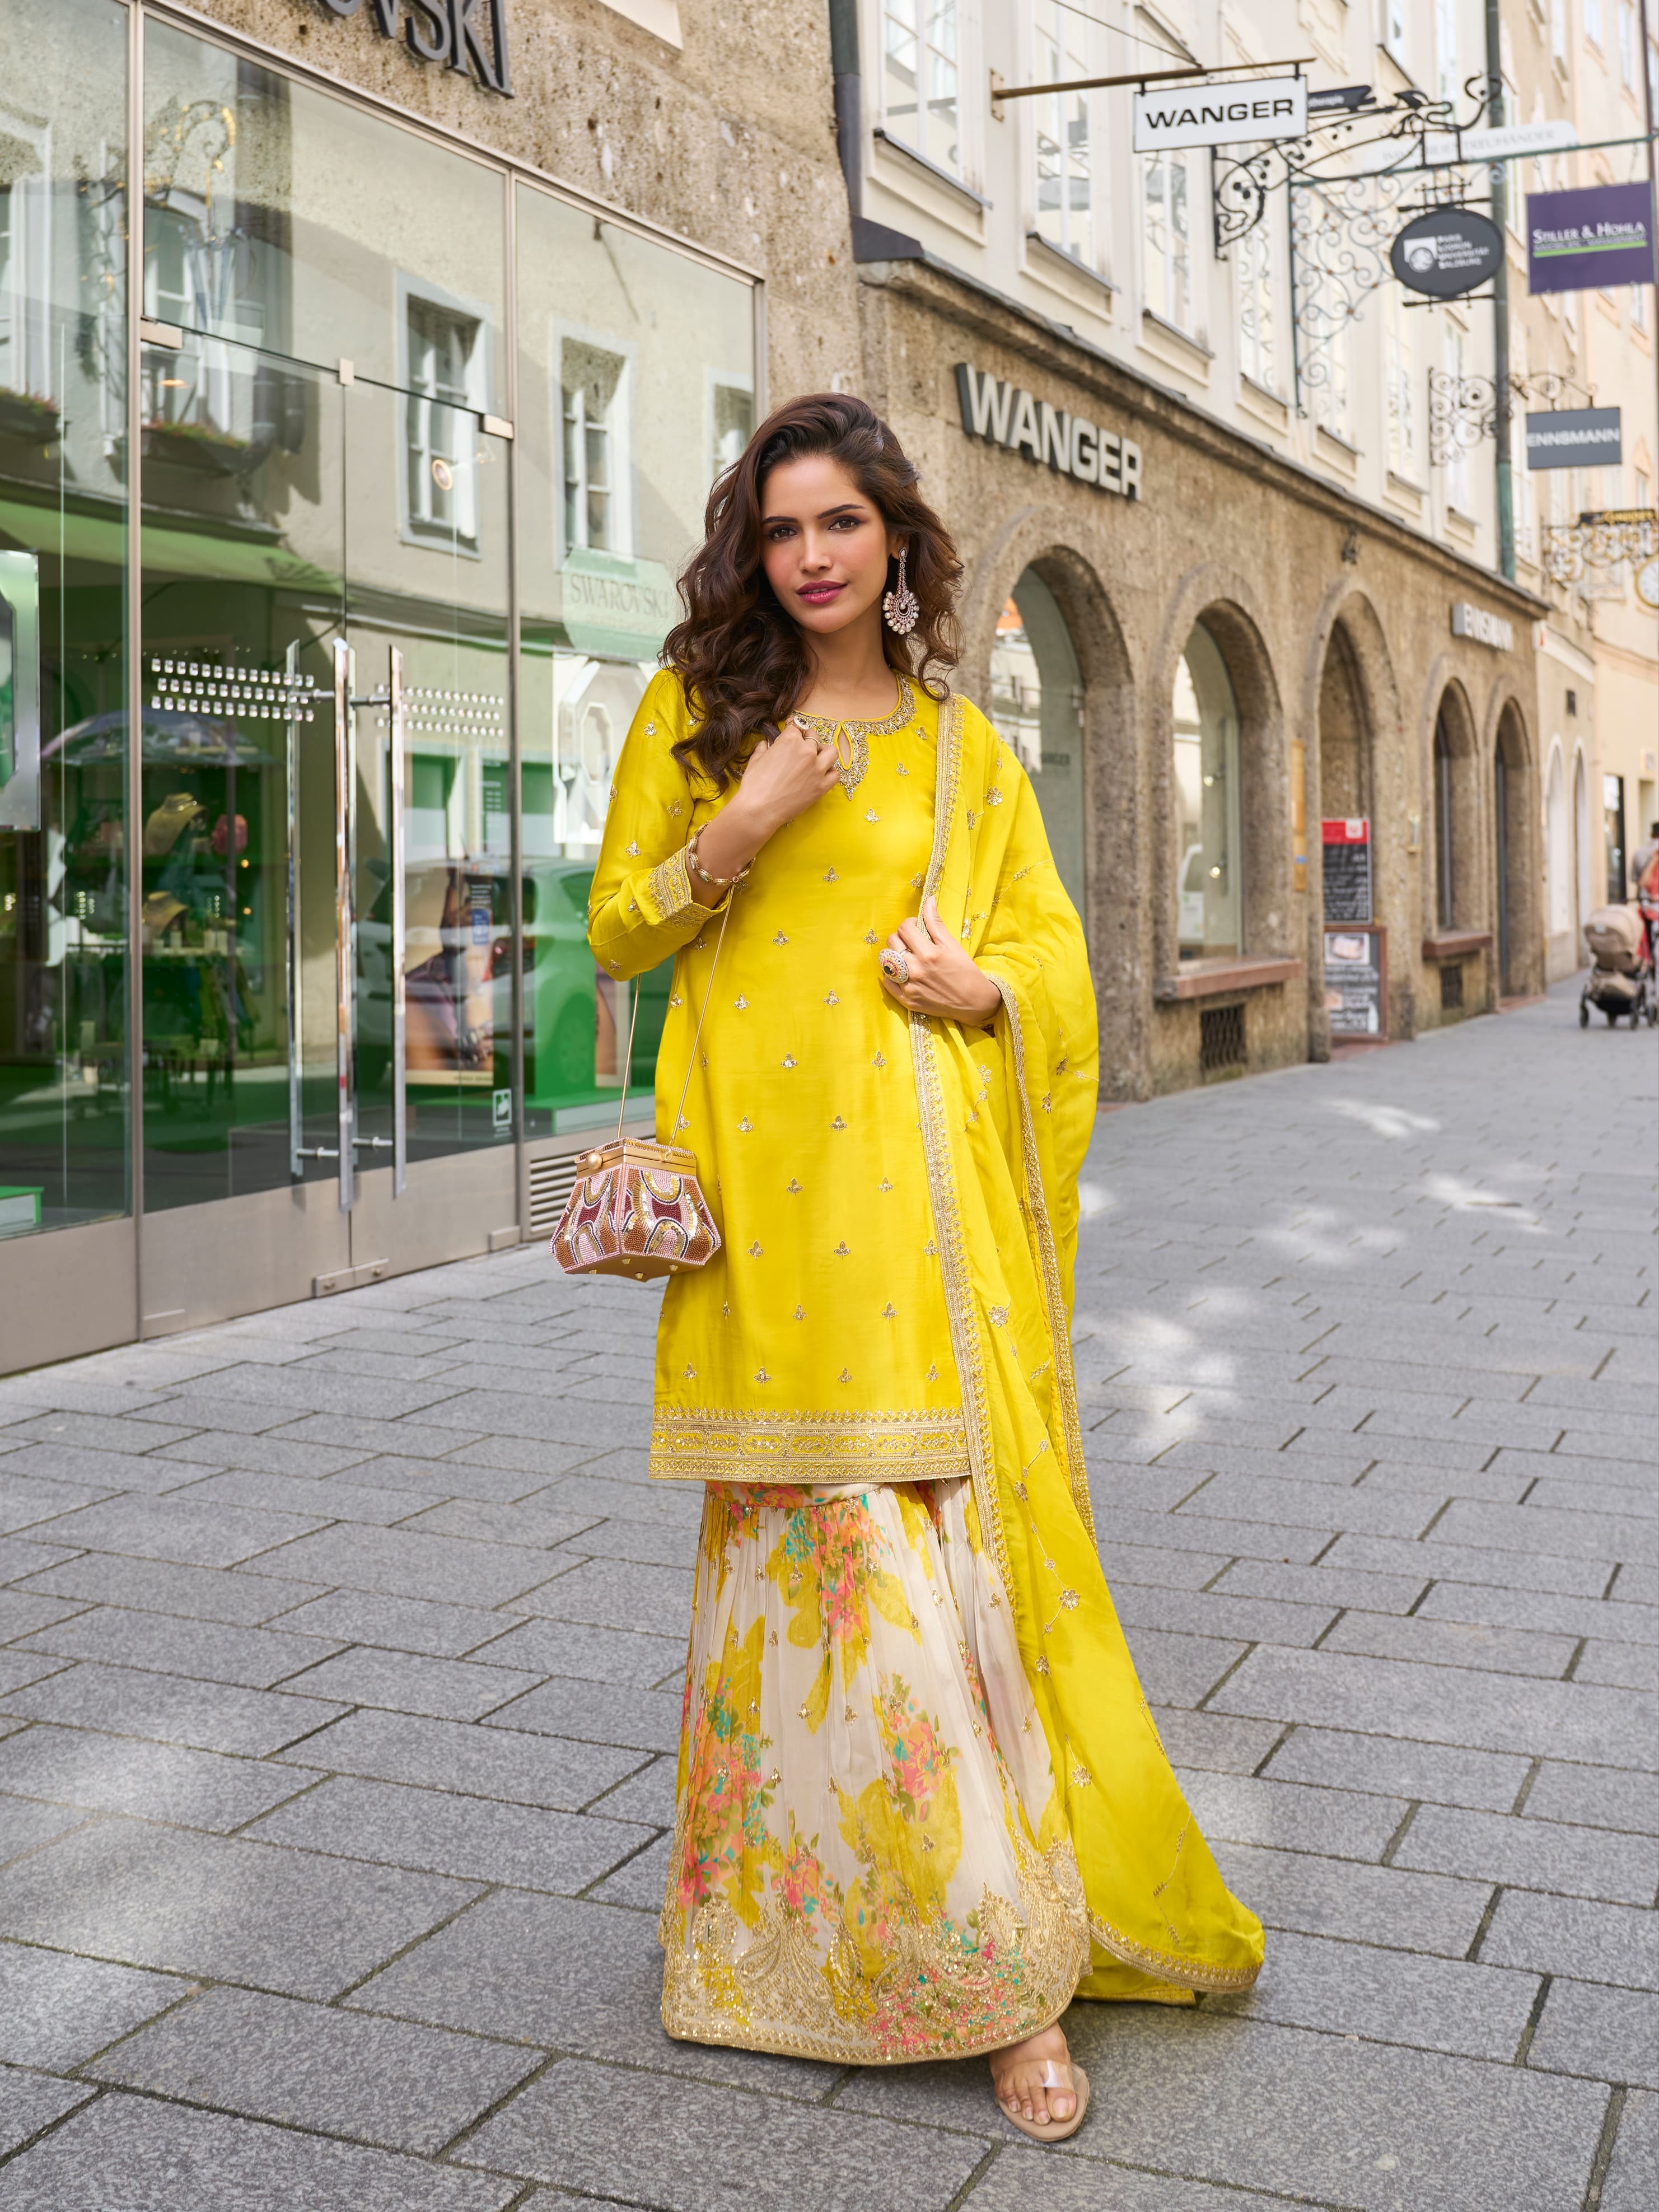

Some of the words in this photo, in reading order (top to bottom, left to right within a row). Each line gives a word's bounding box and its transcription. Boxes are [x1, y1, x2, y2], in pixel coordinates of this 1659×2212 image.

[1146, 99, 1294, 129] WANGER
[1582, 225, 1595, 239] &
[955, 362, 1142, 502] WANGER
[1527, 427, 1620, 447] ENNSMANN
[571, 573, 669, 619] SWAROVSKI
